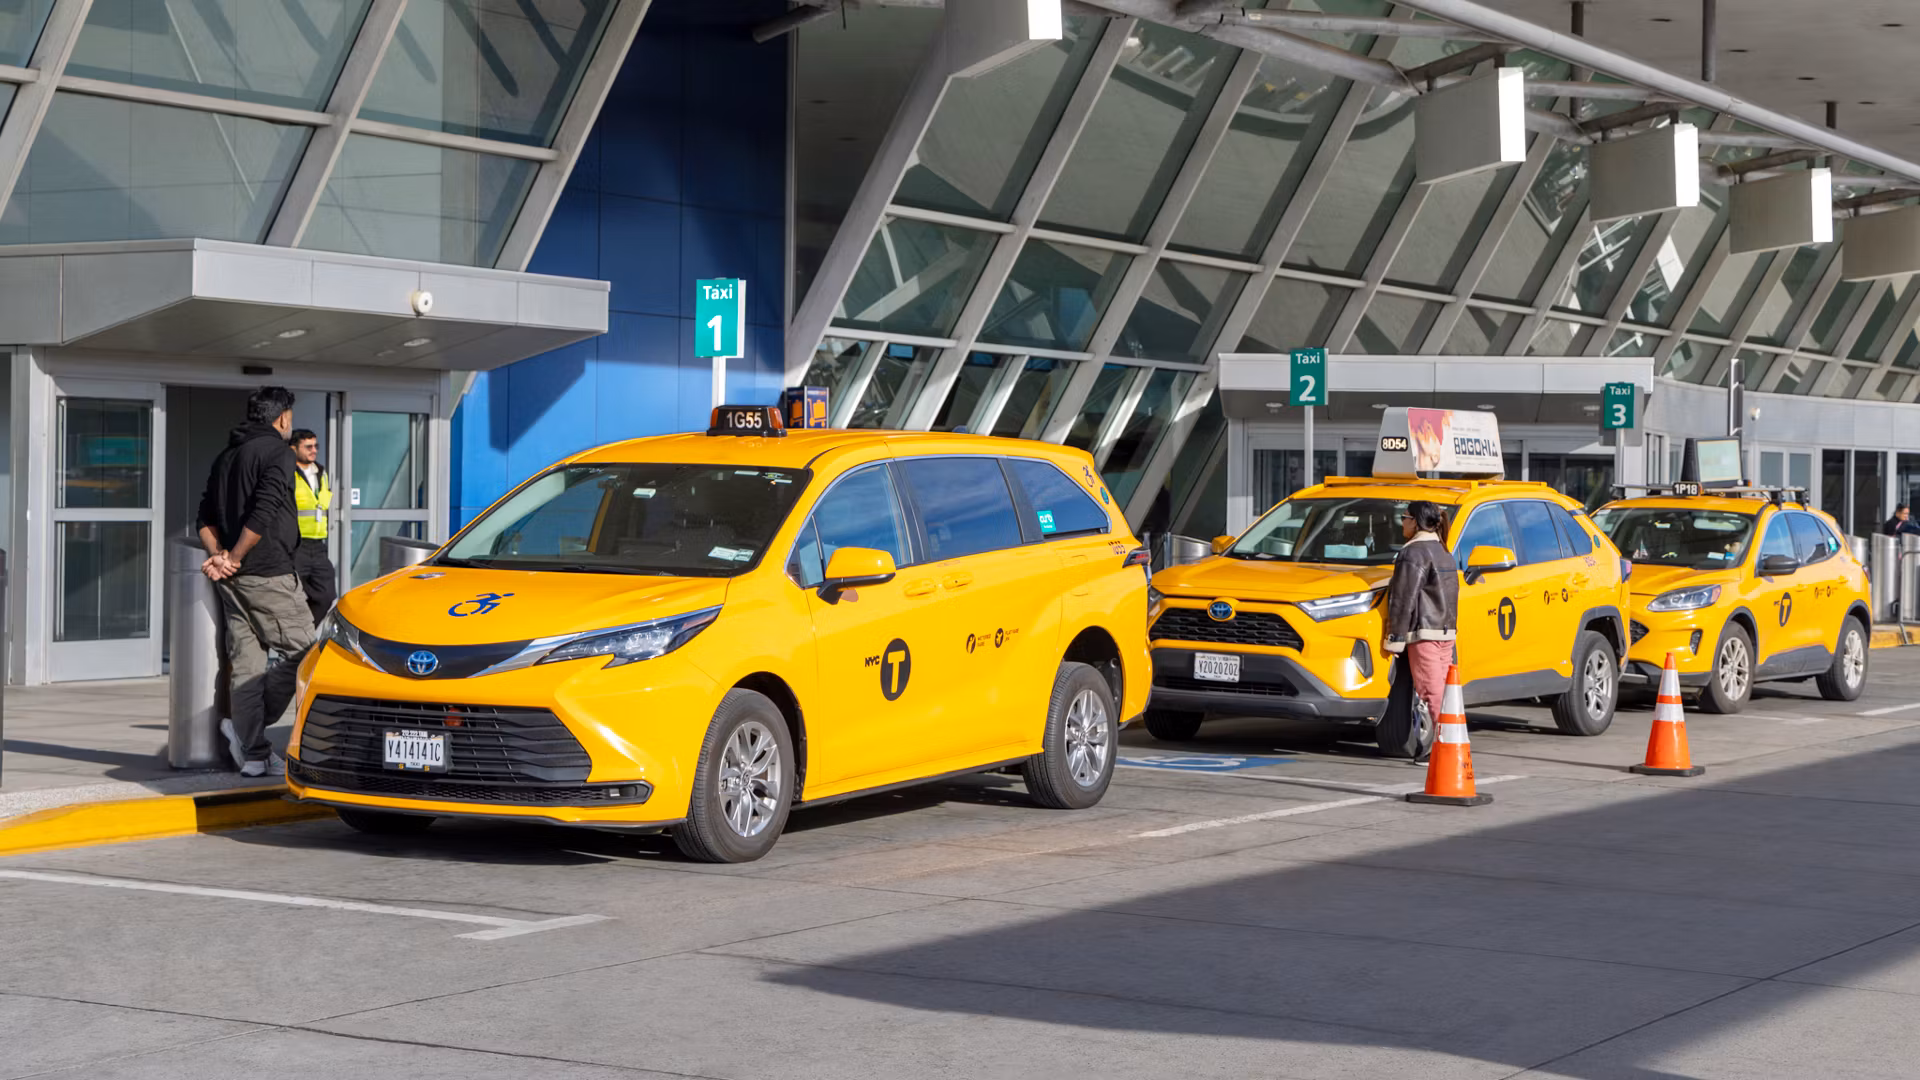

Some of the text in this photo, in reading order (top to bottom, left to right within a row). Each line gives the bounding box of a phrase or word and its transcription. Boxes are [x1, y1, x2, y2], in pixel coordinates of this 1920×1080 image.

[703, 284, 733, 300] Taxi
[707, 315, 722, 351] 1
[1295, 352, 1320, 364] Taxi
[1299, 375, 1316, 401] 2
[1609, 386, 1631, 395] Taxi
[727, 411, 762, 429] 1G55
[1612, 404, 1626, 426] 3
[1382, 438, 1407, 449] 8D54
[1674, 483, 1698, 495] 1P18
[1500, 604, 1513, 636] T
[864, 650, 905, 694] NYC T
[388, 740, 440, 761] Y414141C
